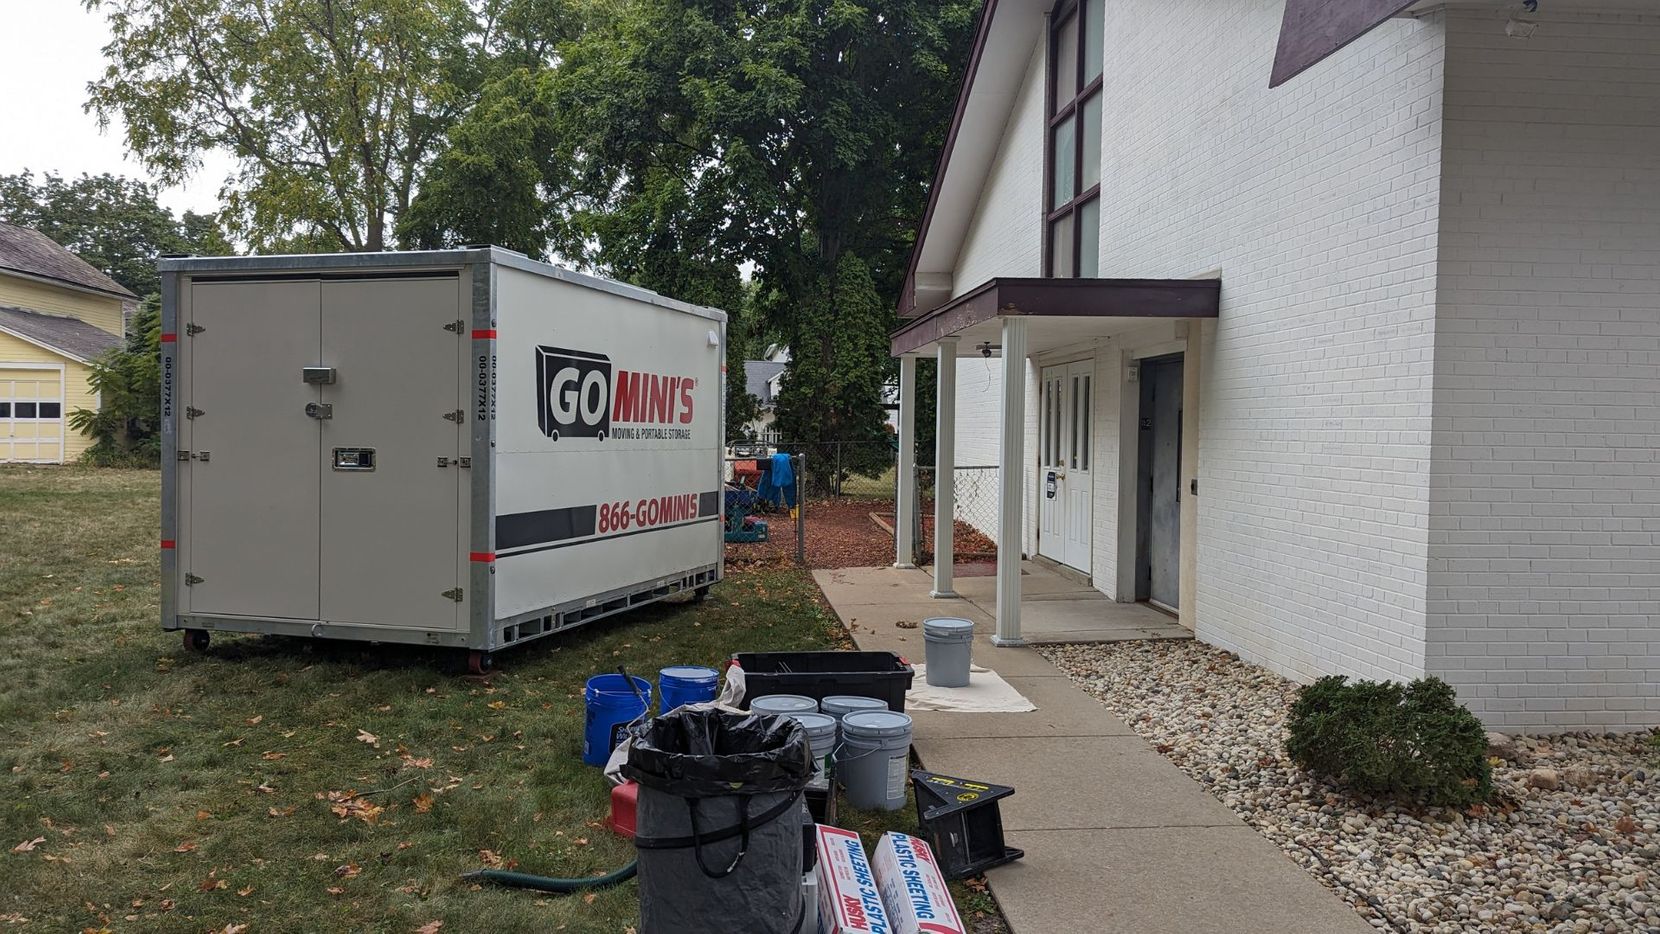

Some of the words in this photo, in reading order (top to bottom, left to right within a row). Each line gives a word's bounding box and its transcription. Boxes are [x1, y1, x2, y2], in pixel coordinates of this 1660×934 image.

[164, 356, 172, 417] 00-0377X12
[478, 355, 487, 421] 00-0377X12
[550, 367, 608, 426] GO
[612, 370, 694, 424] MINI'S
[612, 427, 634, 440] MOVING
[636, 428, 640, 440] &
[641, 428, 667, 440] PORTABLE
[668, 428, 691, 440] STORAGE
[598, 493, 698, 534] 866-GOMINIS
[844, 839, 873, 888] SHEETING
[890, 833, 917, 868] PLASTIC
[843, 894, 869, 931] HUSKY
[859, 887, 888, 934] PLASTIC
[902, 869, 935, 919] SHEETING
